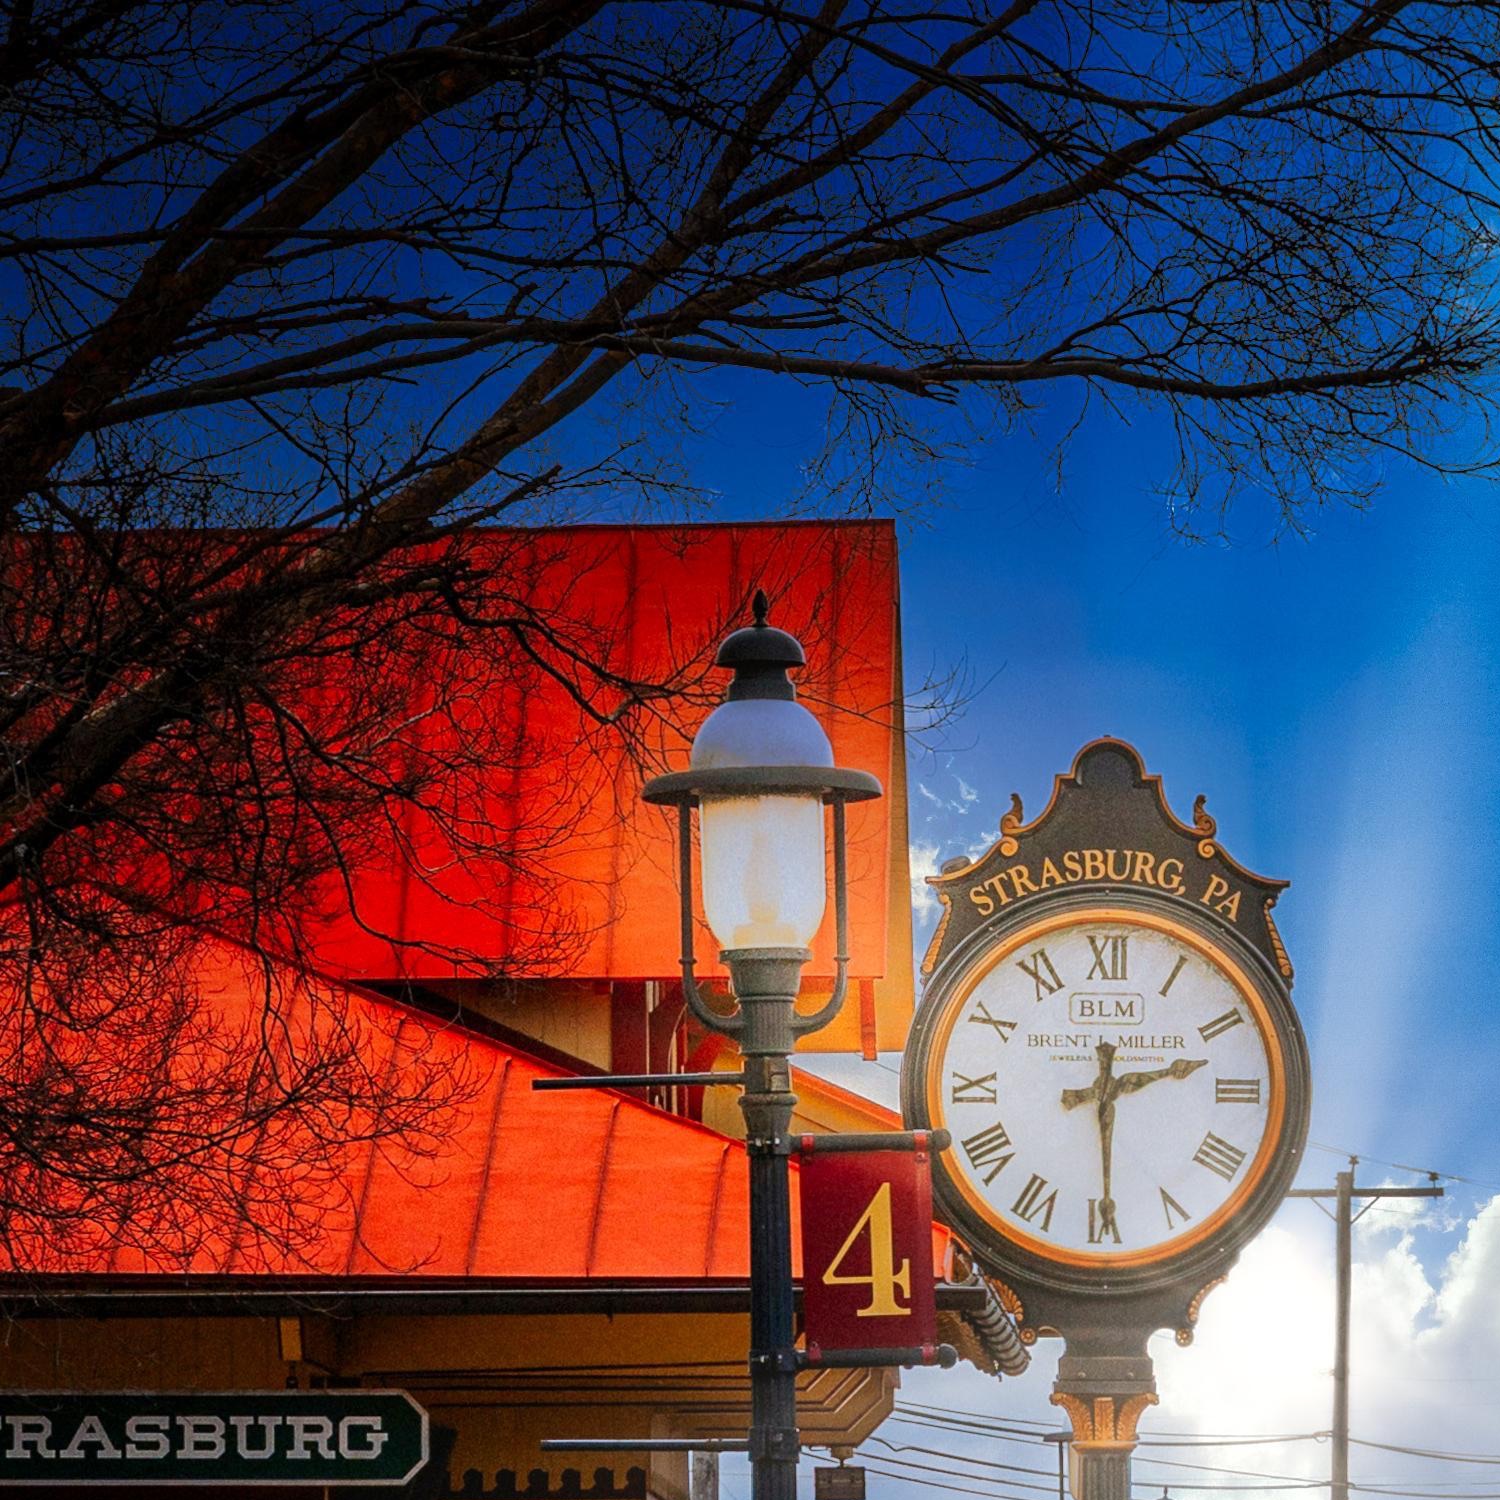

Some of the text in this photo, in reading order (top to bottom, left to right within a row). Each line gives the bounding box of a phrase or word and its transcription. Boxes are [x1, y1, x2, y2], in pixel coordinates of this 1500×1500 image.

[970, 848, 1242, 922] STRASBURG, PA
[1016, 948, 1065, 1001] XI
[1086, 935, 1128, 981] XII
[1158, 954, 1188, 997] I
[968, 1001, 1017, 1043] X
[1079, 1000, 1135, 1018] BLM
[1197, 1008, 1244, 1042] II
[1027, 1034, 1092, 1048] BRENT
[1118, 1035, 1186, 1049] MILLER
[952, 1071, 997, 1104] IX
[1215, 1078, 1260, 1105] III
[961, 1121, 1016, 1187] VIII
[1010, 1173, 1059, 1233] VII
[1159, 1186, 1191, 1230] V
[822, 1182, 912, 1317] 4
[0, 1414, 390, 1460] RASBURG
